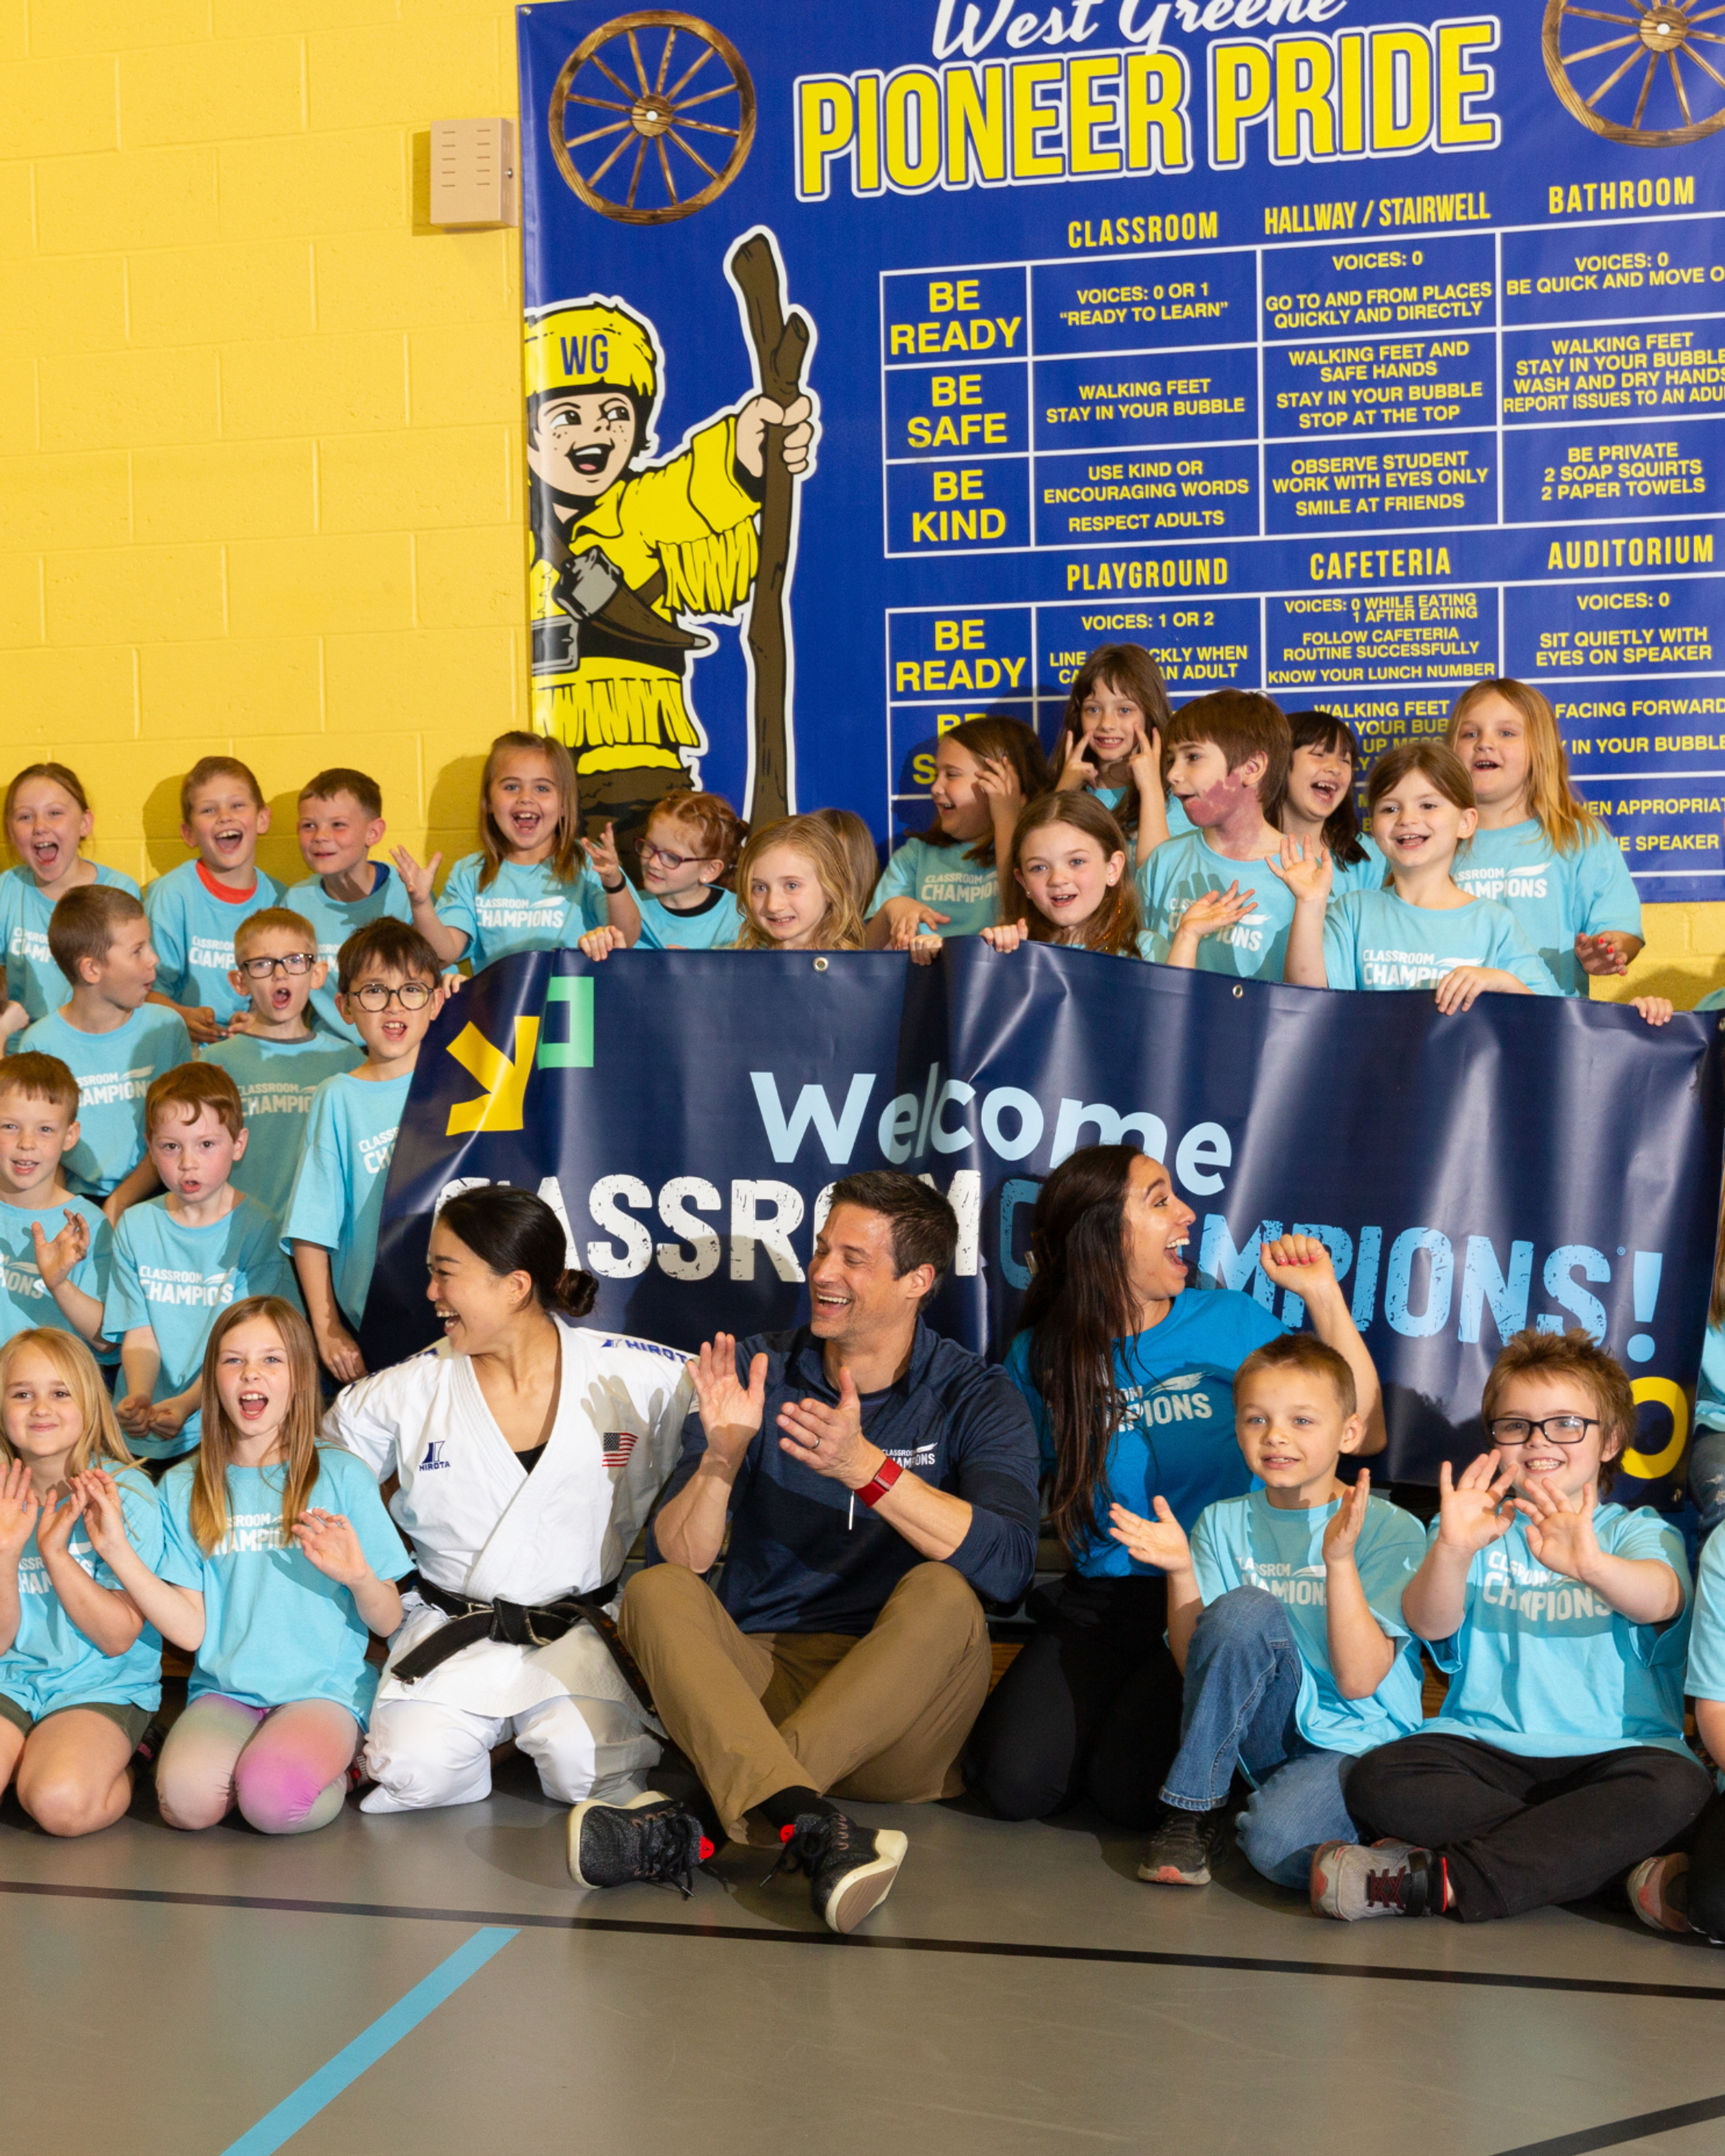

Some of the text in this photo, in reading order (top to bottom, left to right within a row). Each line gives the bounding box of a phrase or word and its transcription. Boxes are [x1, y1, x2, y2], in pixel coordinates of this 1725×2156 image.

[932, 0, 1347, 60] West Greene
[794, 15, 1501, 203] PIONEER PRIDE
[1549, 177, 1694, 213] BATHROOM
[1265, 202, 1357, 234] HALLWAY
[1380, 192, 1491, 226] STAIRWELL
[1069, 212, 1217, 248] CLASSROOM
[1333, 251, 1423, 270] VOICES: 0
[1575, 252, 1668, 271] VOICES: 0
[1507, 268, 1704, 295] BE QUICK AND MOVE
[929, 280, 980, 312] BE
[1077, 283, 1208, 304] VOICES: 0 OR 1
[1266, 282, 1492, 311] GO TO AND FROM PLACES
[1132, 306, 1156, 321] TO
[1275, 301, 1482, 328] QUICKLY AND DIRECTLY
[891, 317, 1021, 354] READY
[1552, 332, 1693, 354] WALKING FEET
[560, 334, 608, 376] WG
[1289, 341, 1469, 365] WALKING FEET AND
[1321, 361, 1437, 382] SAFE HANDS
[1517, 359, 1564, 376] STAY
[1570, 357, 1588, 372] IN
[1594, 354, 1647, 370] YOUR
[932, 374, 982, 407] BE
[1079, 378, 1211, 399] WALKING FEET
[1514, 371, 1660, 394] WASH AND DRY
[1277, 382, 1482, 408] STAY IN YOUR BUBBLE
[1504, 389, 1685, 412] REPORT ISSUES TO AN
[1047, 398, 1245, 423] STAY IN YOUR BUBBLE
[1300, 405, 1460, 428] STOP AT THE TOP
[908, 413, 1007, 448] SAFE
[1292, 451, 1468, 474] OBSERVE STUDENT
[1569, 443, 1678, 462] BE PRIVATE
[1089, 460, 1203, 480] USE KIND OR
[1273, 468, 1488, 493] WORK WITH EYES ONLY
[1545, 459, 1702, 482] 2 SOAP SQUIRTS
[933, 469, 983, 501] BE
[1044, 479, 1249, 503] ENCOURAGING WORDS
[1542, 478, 1705, 500] 2 PAPER TOWELS
[1296, 493, 1464, 516] SMILE AT FRIENDS
[913, 509, 1006, 542] KIND
[1069, 510, 1224, 531] RESPECT ADULTS
[1548, 535, 1713, 569] AUDITORIUM
[1067, 558, 1227, 591] PLAYGROUND
[1311, 548, 1451, 580] CAFETERIA
[1284, 593, 1476, 613] VOICES: 0 WHILE EATING
[1577, 593, 1670, 610] VOICES: 0
[1082, 612, 1214, 630] VOICES: 1 OR 2
[1353, 607, 1477, 622] 1 AFTER EATING
[935, 620, 985, 651] BE
[1303, 627, 1459, 645] FOLLOW CAFETERIA
[1540, 627, 1707, 648] SIT QUIETLY WITH
[1050, 646, 1247, 667] LINE WHEN
[1284, 642, 1479, 660] ROUTINE SUCCESSFULLY
[1537, 645, 1712, 666] EYES ON SPEAKER
[897, 657, 1026, 691] READY
[1183, 663, 1238, 679] ADULT
[1269, 663, 1495, 683] KNOW YOUR LUNCH NUMBER
[1405, 700, 1450, 715] FEET
[1555, 702, 1626, 718] FACING
[1355, 720, 1406, 735] YOUR
[1573, 739, 1590, 754] IN
[1597, 738, 1649, 753] YOUR
[1636, 834, 1719, 850] SPEAKER
[925, 872, 983, 885] CLASSROOM
[475, 896, 530, 909] CLASSROOM
[476, 908, 564, 928] CHAMPIONS
[1362, 949, 1435, 965] CLASSROOM
[749, 1062, 1232, 1196] Welcome
[625, 1339, 688, 1364] HIROT
[419, 1461, 451, 1471] HIROTA
